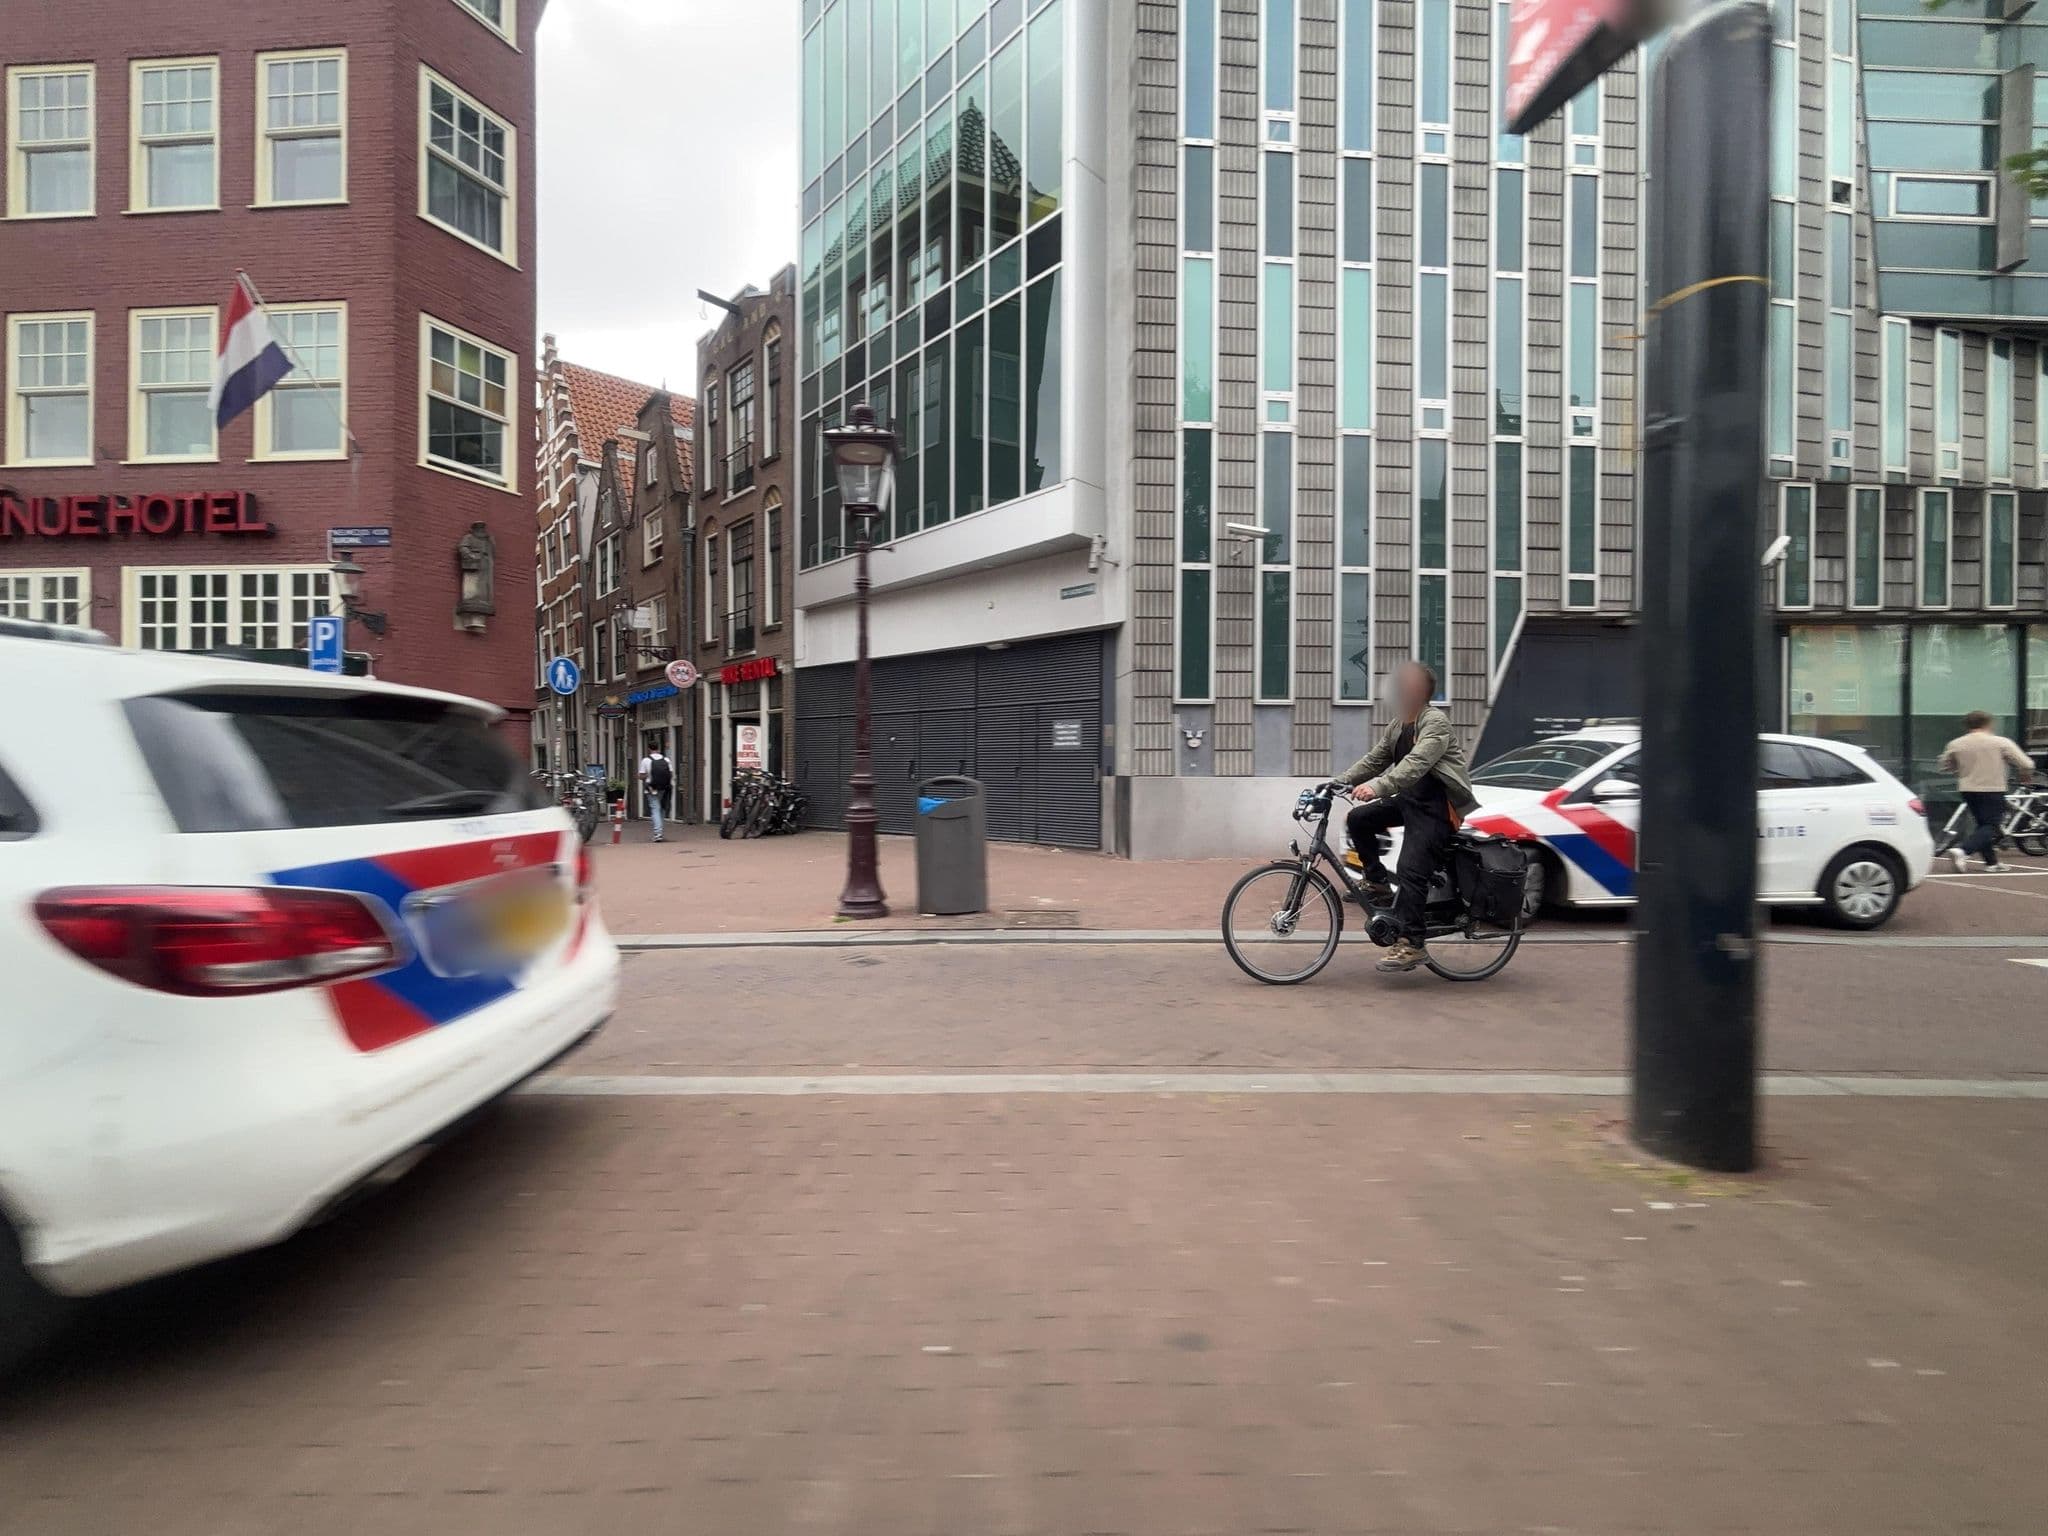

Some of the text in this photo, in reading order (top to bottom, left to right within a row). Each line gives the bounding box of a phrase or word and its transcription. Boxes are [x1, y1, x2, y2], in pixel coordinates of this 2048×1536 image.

[0, 491, 268, 535] NUE HOTEL
[316, 622, 335, 651] P
